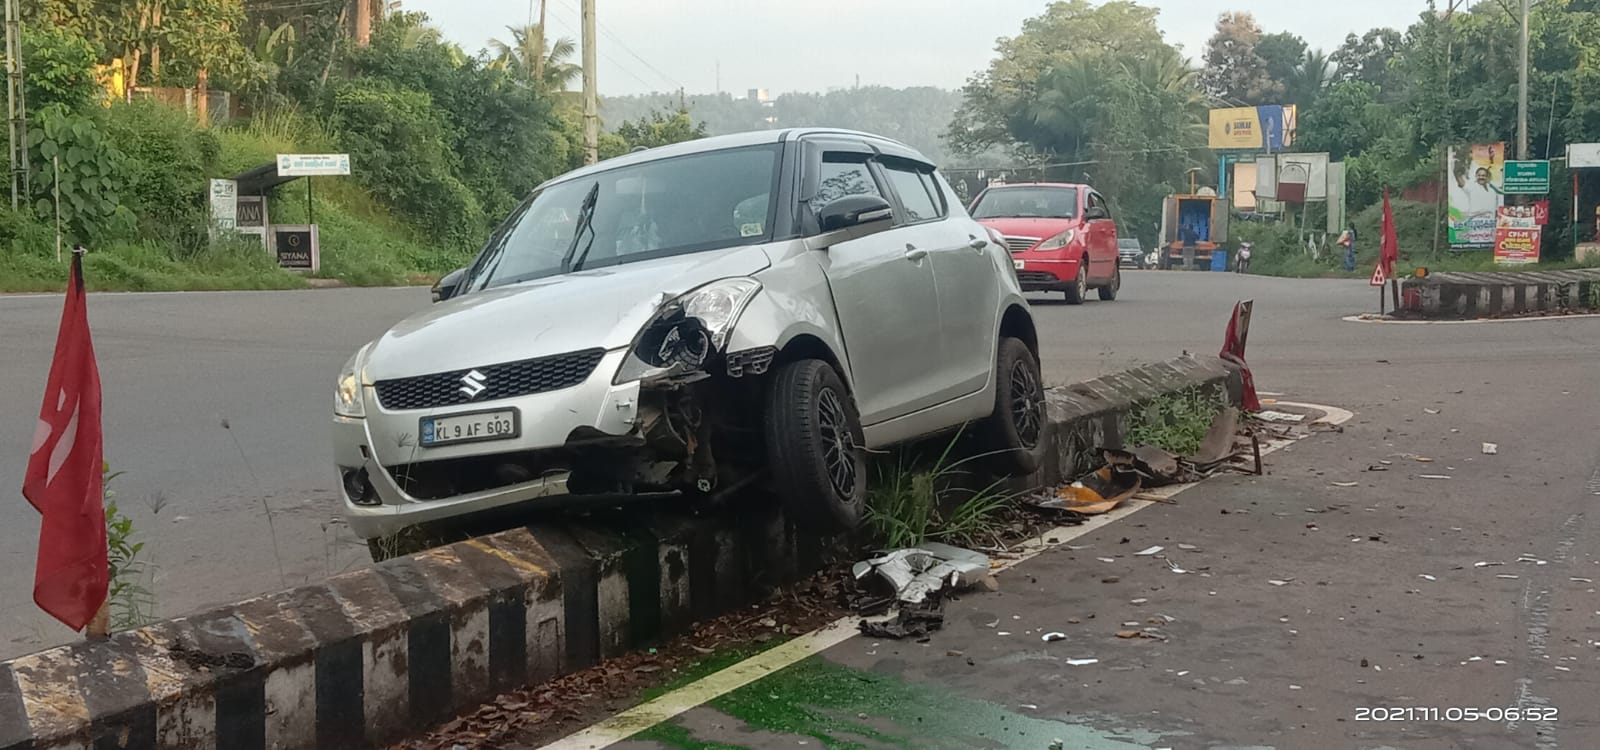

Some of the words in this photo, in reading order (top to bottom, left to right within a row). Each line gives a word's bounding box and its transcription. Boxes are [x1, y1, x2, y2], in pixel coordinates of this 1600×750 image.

[436, 427, 450, 440] KL
[454, 425, 462, 438] 9
[467, 423, 481, 436] AF
[487, 420, 510, 434] 603
